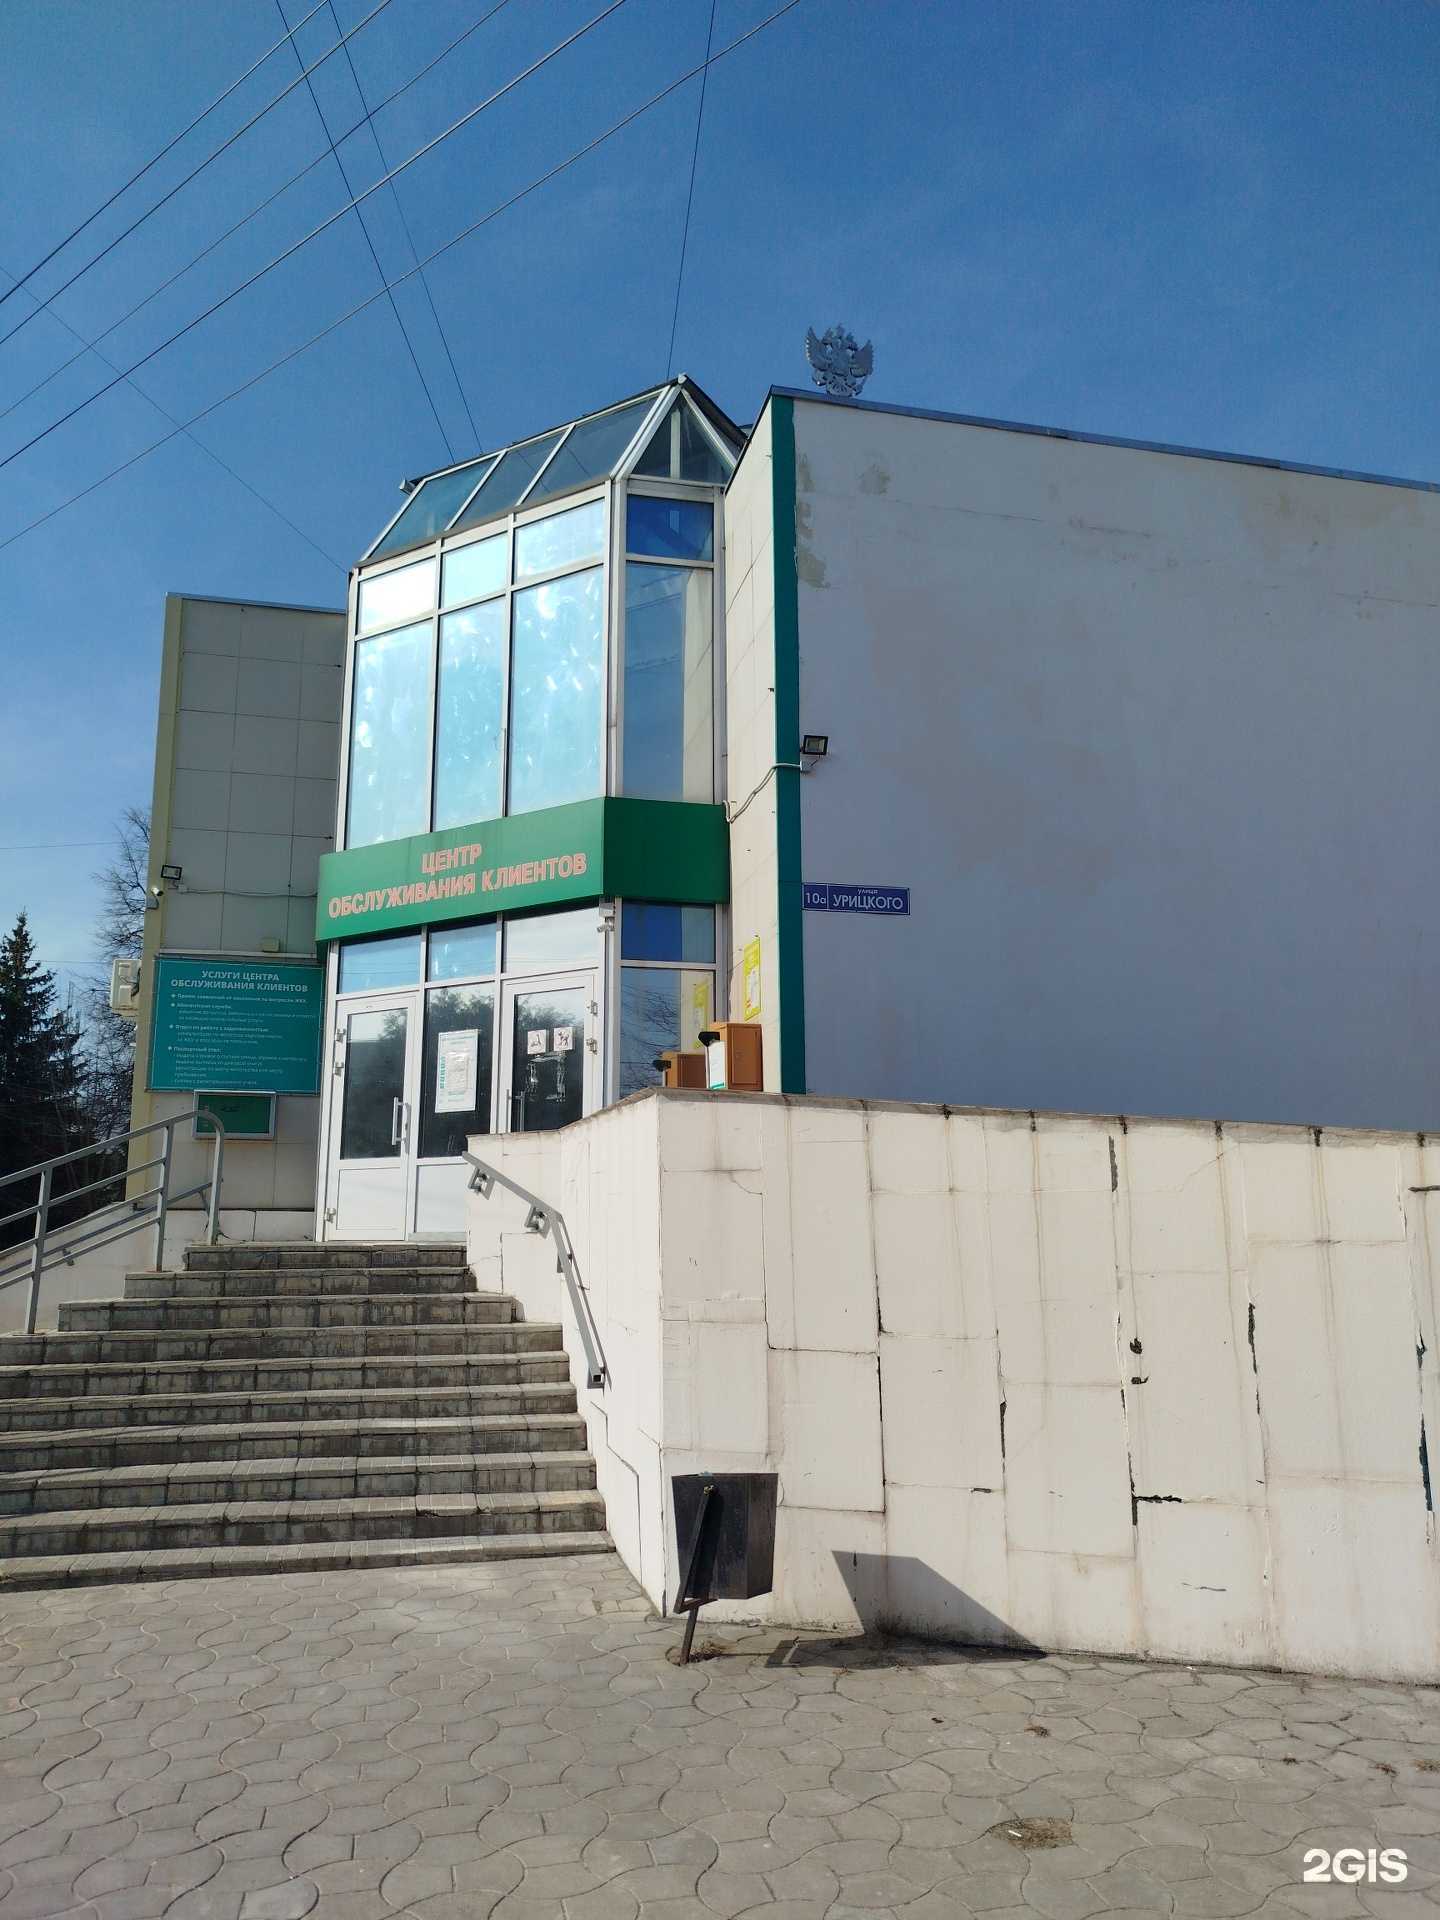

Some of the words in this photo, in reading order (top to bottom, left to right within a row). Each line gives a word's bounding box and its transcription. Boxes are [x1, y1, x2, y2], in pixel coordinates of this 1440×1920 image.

[420, 843, 483, 876] ЦЕНТР
[328, 873, 476, 918] ОБСЛУЖИВАНИЯ
[481, 853, 588, 892] КЛИЕНТОВ
[832, 894, 904, 910] УРИЦКОГО
[201, 970, 241, 980] УСЛУГИ
[242, 972, 280, 982] ЦЕНТРА
[170, 979, 256, 990] ОБСЛУЖИВАНИЯ
[257, 982, 309, 993] КЛИЕНТОВ
